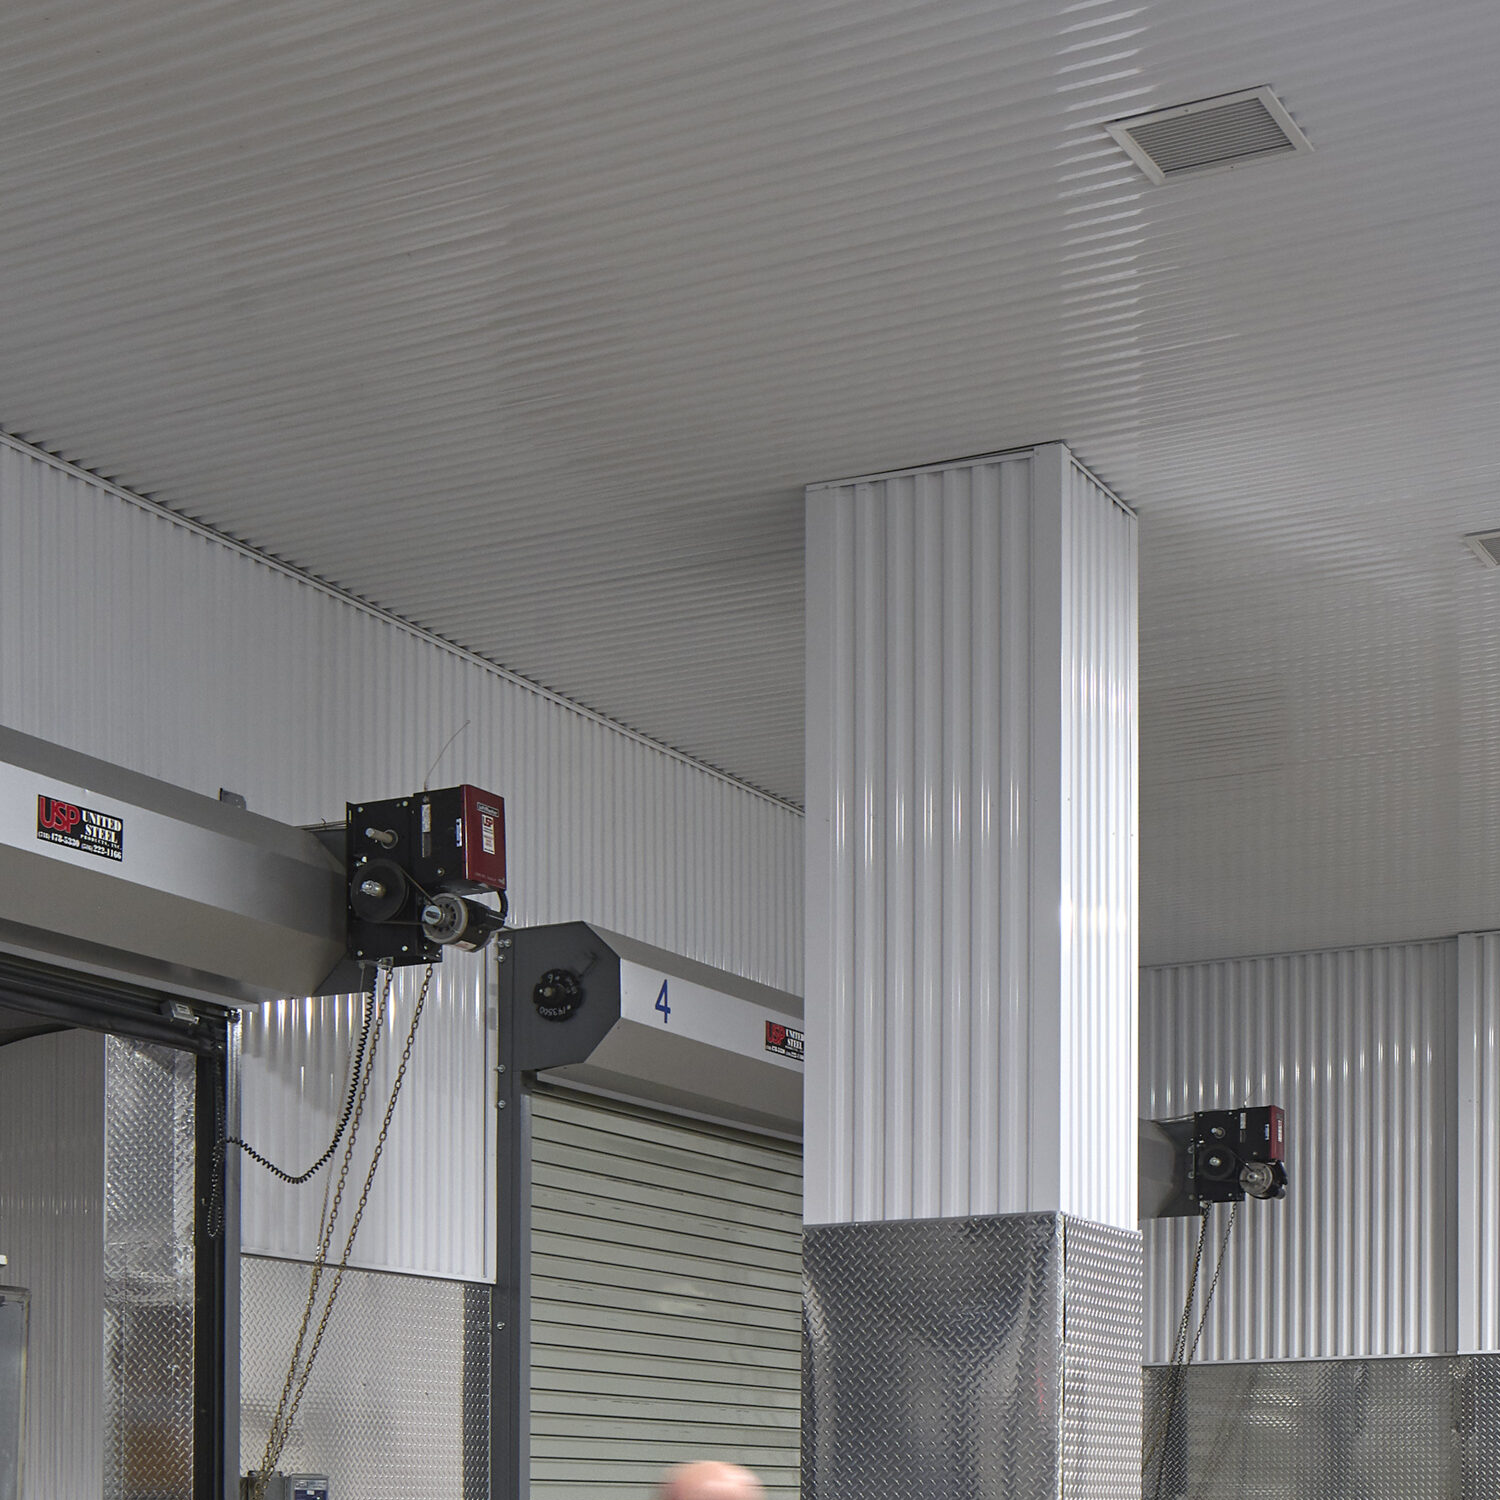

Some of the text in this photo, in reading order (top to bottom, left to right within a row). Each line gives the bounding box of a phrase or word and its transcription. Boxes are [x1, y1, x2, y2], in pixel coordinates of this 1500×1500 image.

[40, 796, 80, 833] USP
[82, 809, 122, 832] UNITED
[85, 824, 118, 844] STEEL
[655, 979, 671, 1024] 4
[766, 1022, 786, 1045] USP
